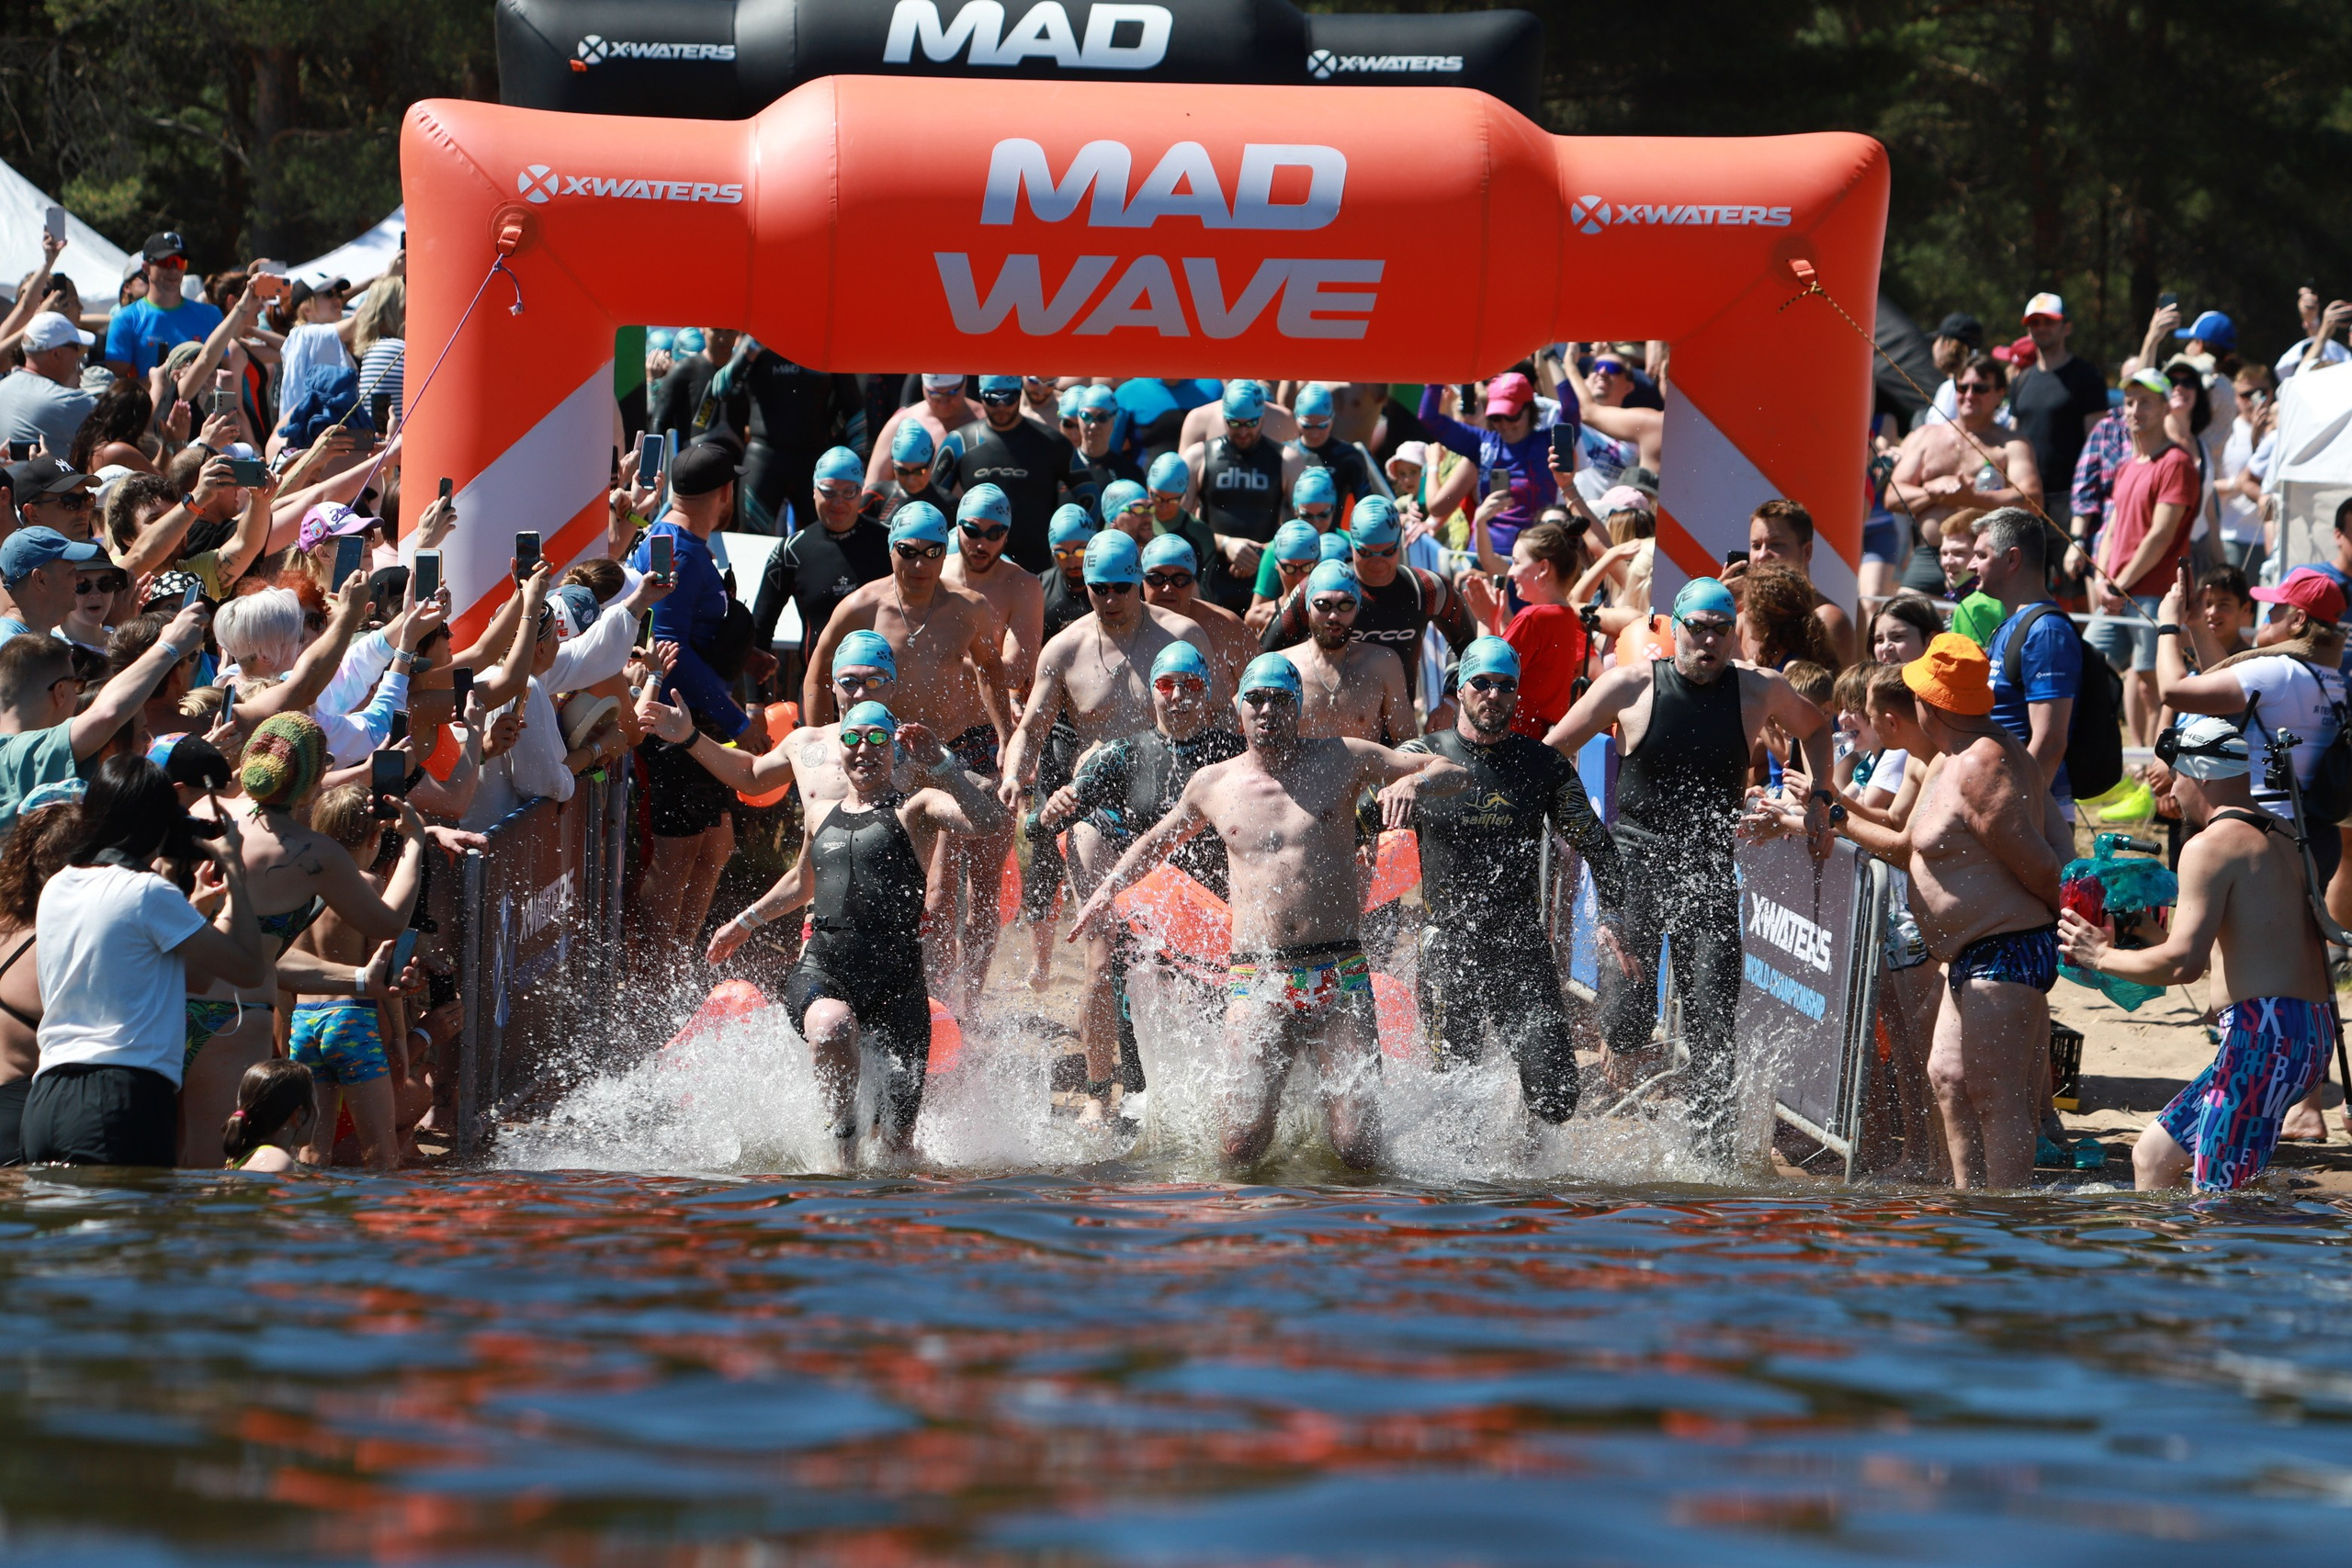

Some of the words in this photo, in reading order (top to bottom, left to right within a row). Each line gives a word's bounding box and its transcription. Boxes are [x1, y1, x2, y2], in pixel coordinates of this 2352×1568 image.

[883, 0, 1173, 70] MAD
[979, 138, 1347, 230] MAD
[933, 252, 1385, 339] WAVE
[974, 467, 1028, 478] orca
[1216, 467, 1269, 490] dhb
[1462, 813, 1514, 828] sailfish
